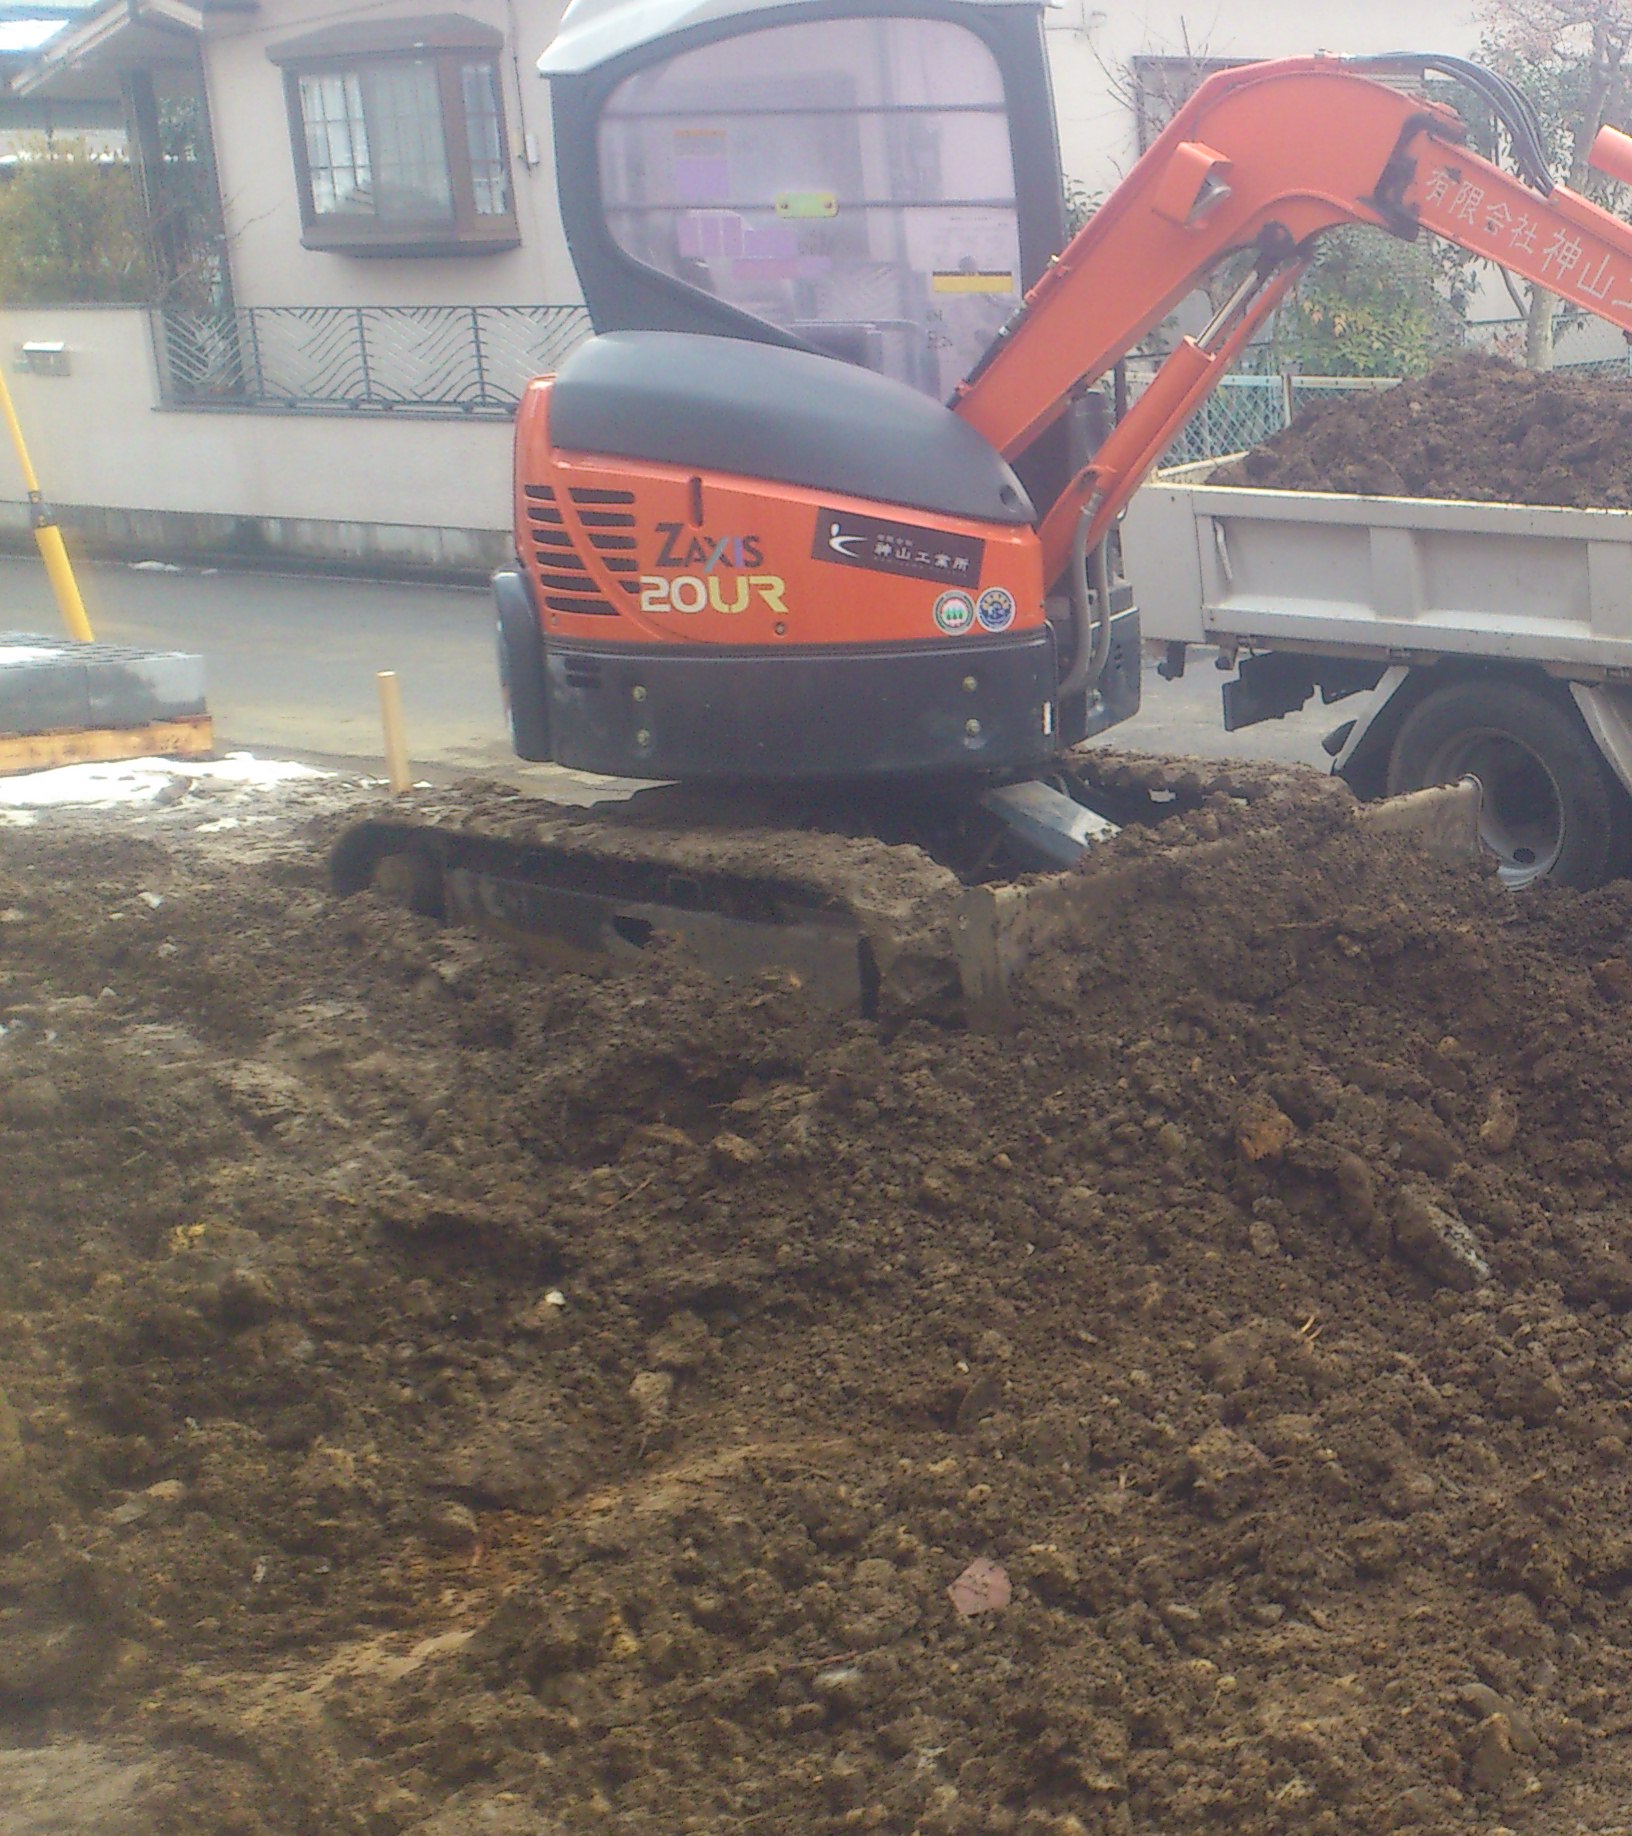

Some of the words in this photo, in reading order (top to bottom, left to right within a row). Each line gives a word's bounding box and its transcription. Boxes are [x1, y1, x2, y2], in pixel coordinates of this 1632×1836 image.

[1425, 168, 1540, 255] 有限会社
[655, 522, 764, 574] ZAXIS
[640, 575, 789, 613] 20UR
